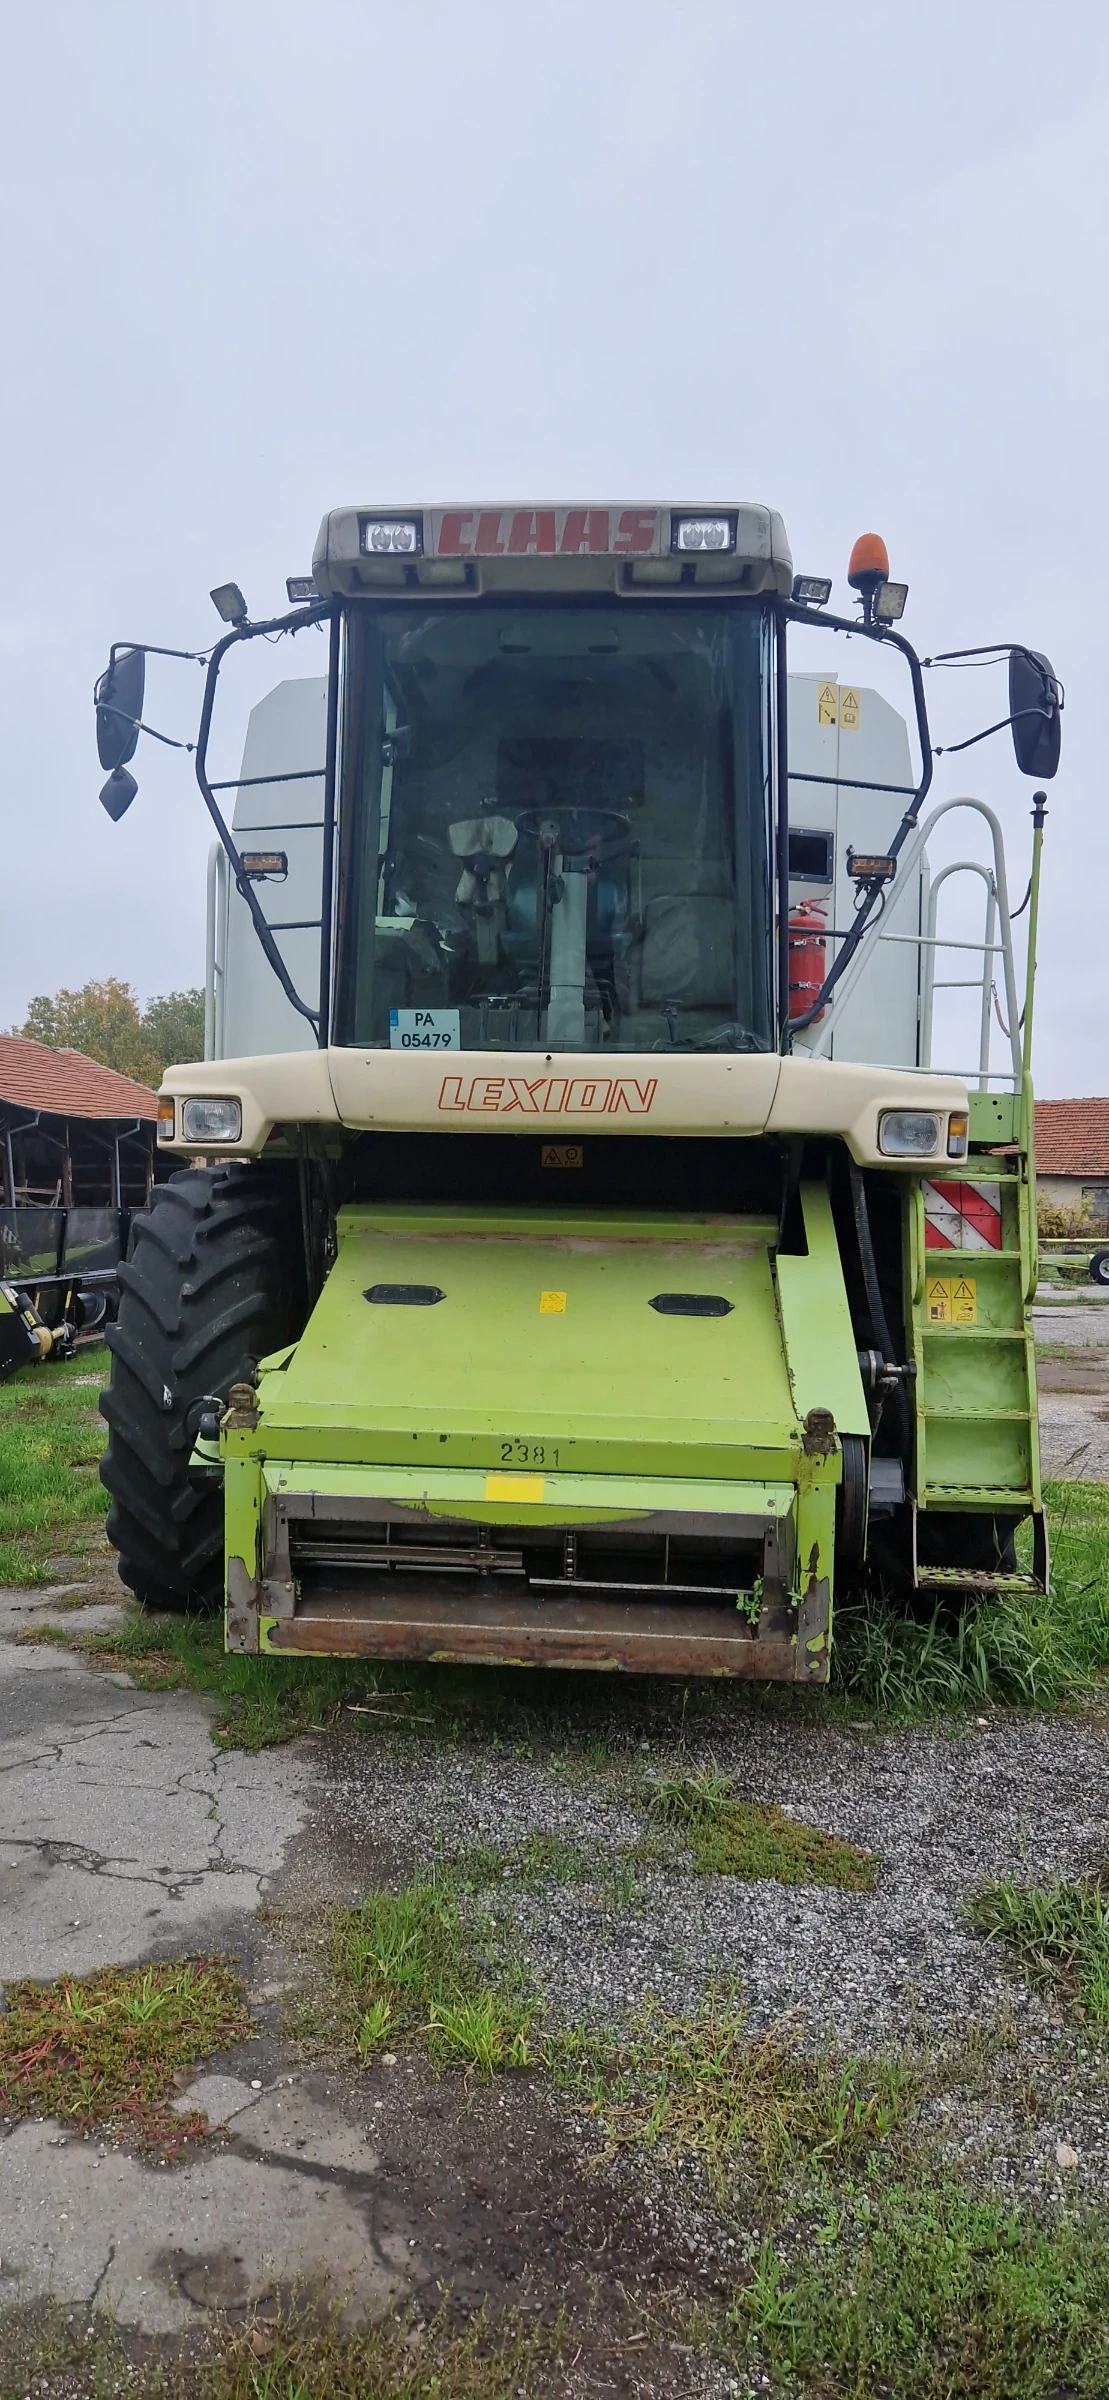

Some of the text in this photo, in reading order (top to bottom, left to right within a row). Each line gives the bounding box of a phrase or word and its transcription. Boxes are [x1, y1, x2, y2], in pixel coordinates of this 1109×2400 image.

[437, 510, 658, 554] CLAAS
[414, 1012, 435, 1026] PA
[401, 1033, 452, 1047] 05479
[438, 1076, 658, 1113] LEXION
[501, 1443, 559, 1467] 2381
